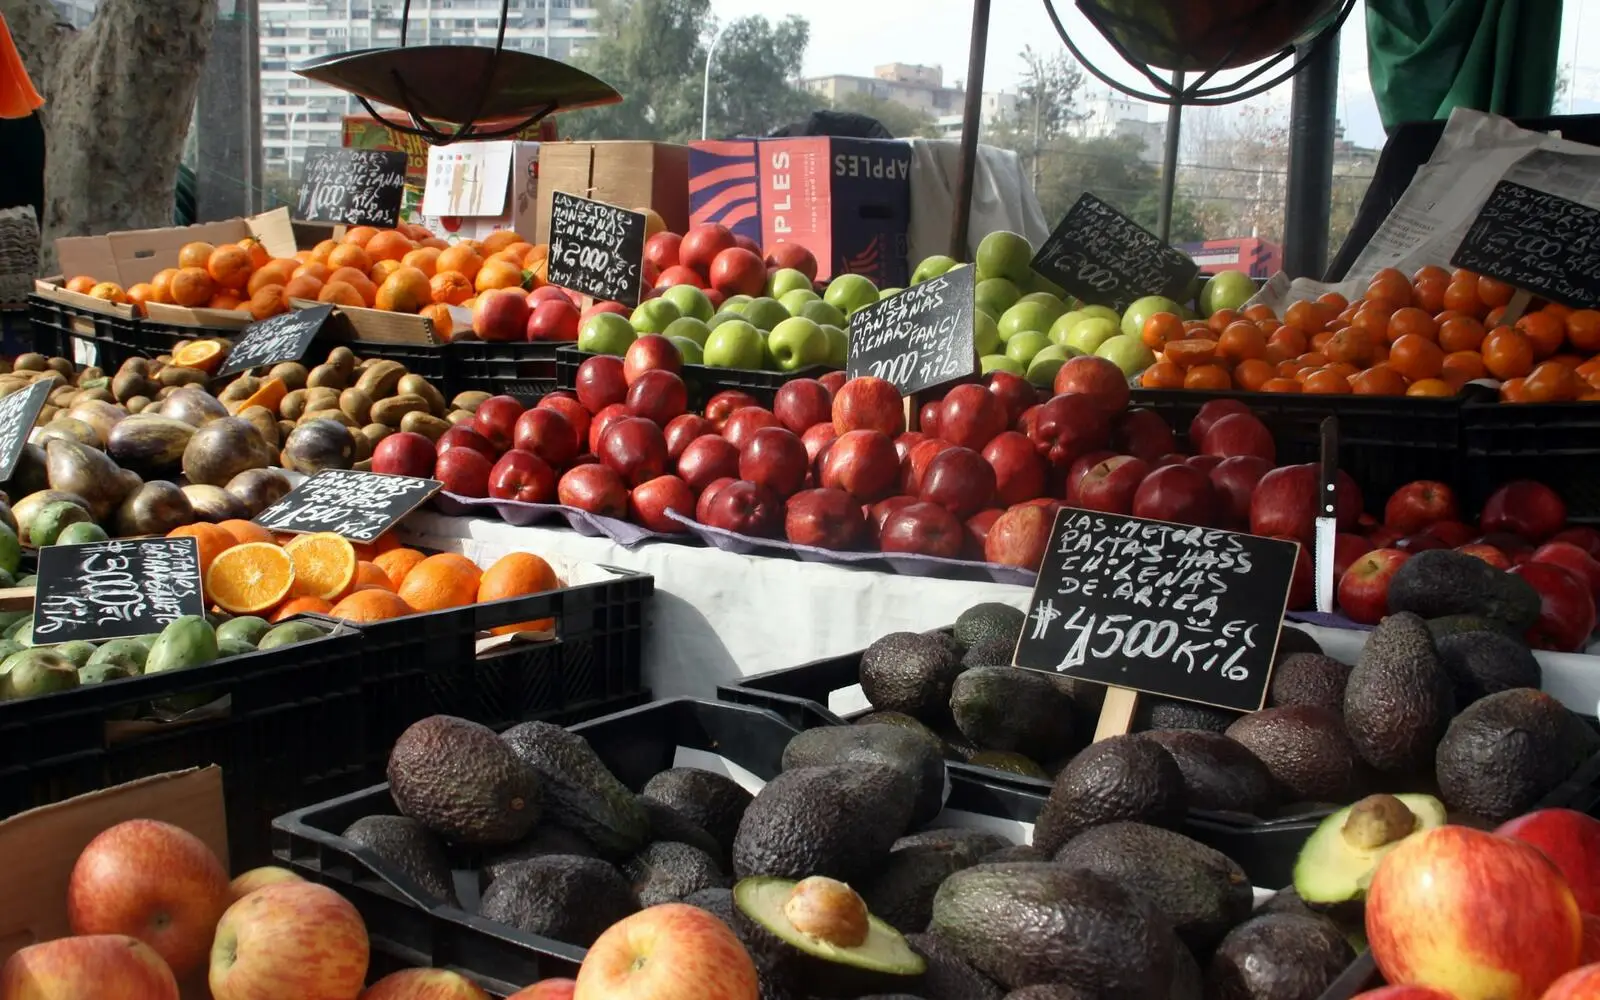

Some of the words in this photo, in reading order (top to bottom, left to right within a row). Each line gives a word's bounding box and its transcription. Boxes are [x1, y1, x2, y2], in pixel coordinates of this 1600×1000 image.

[835, 154, 909, 180] APPLES
[553, 206, 625, 236] MANZANAS
[852, 311, 872, 327] LAS
[876, 277, 949, 315] MEJORES
[852, 292, 944, 343] MANZANAS
[1063, 512, 1107, 530] LAS
[1119, 519, 1244, 553] MEJORES
[77, 540, 144, 606] $3000
[165, 539, 200, 598] PLATANOS
[1061, 555, 1228, 594] CHILENAS
[1057, 576, 1100, 596] DE
[1112, 581, 1219, 617] ARICA
